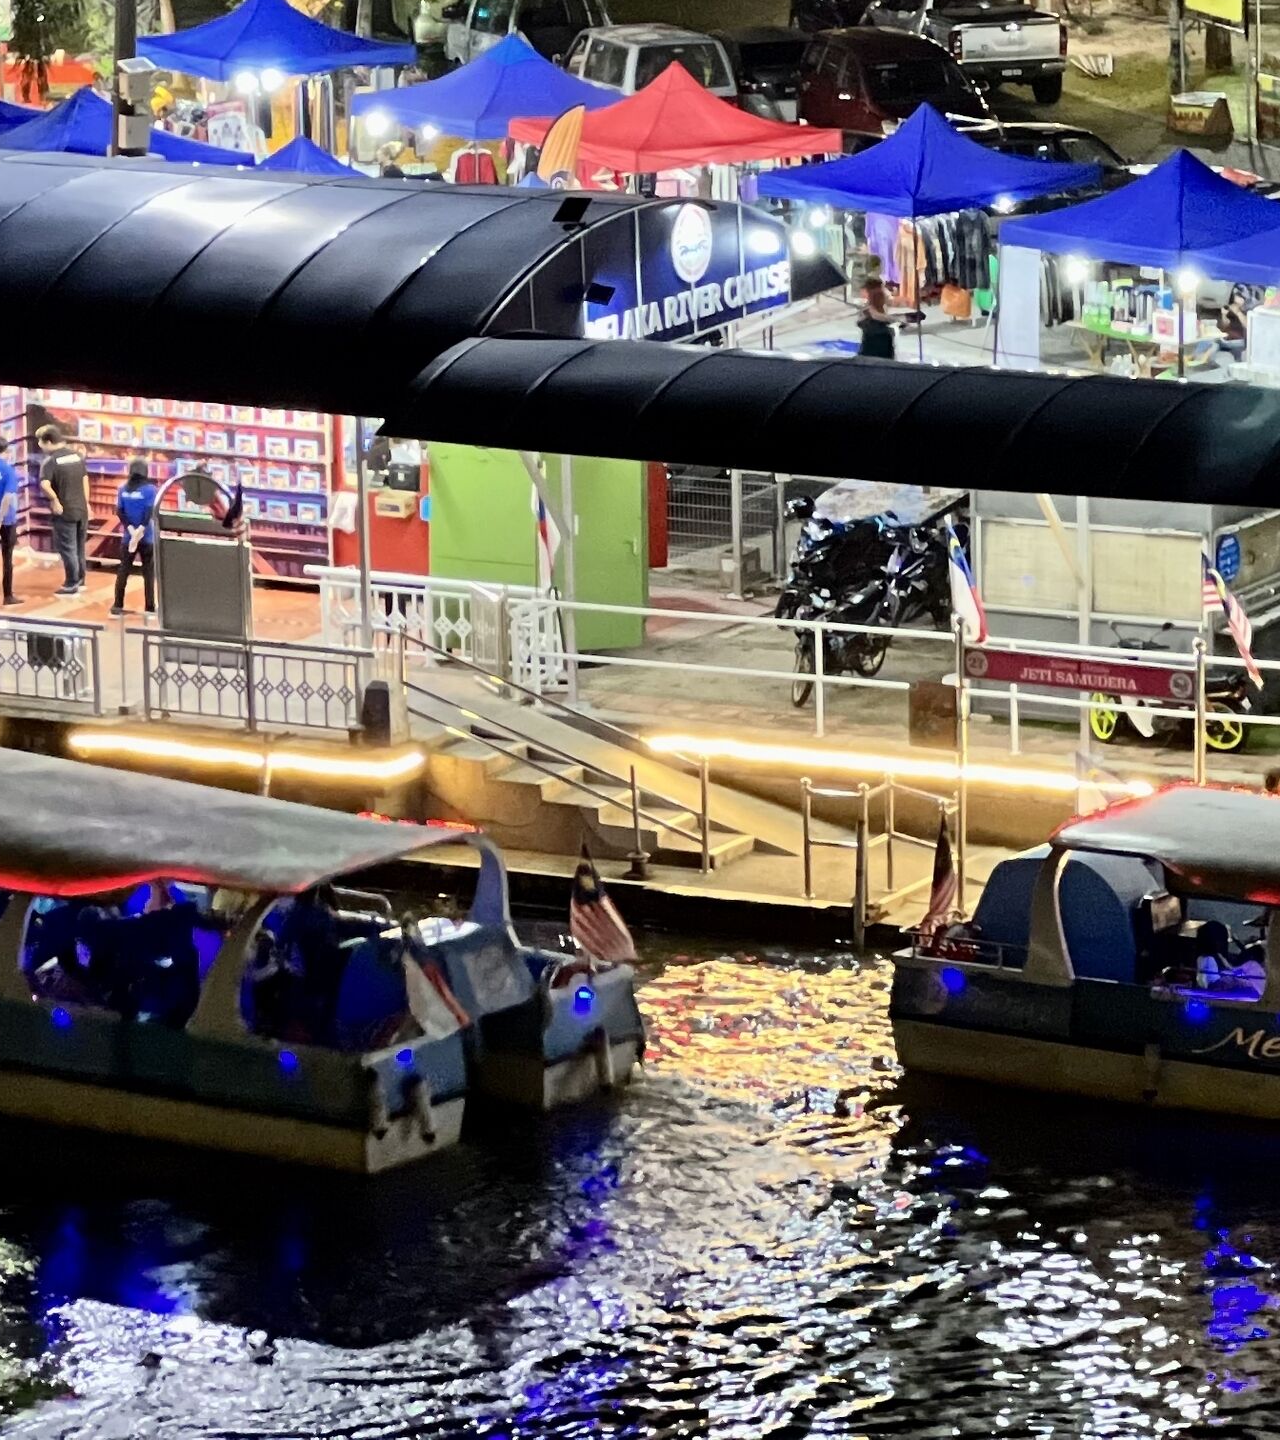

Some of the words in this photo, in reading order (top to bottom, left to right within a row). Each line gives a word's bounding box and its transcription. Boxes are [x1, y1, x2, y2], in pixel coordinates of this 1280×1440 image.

[664, 282, 724, 328] RIVER
[723, 259, 791, 308] CRUISE
[1020, 667, 1052, 682] JETI
[1055, 669, 1137, 691] SAMUDERA
